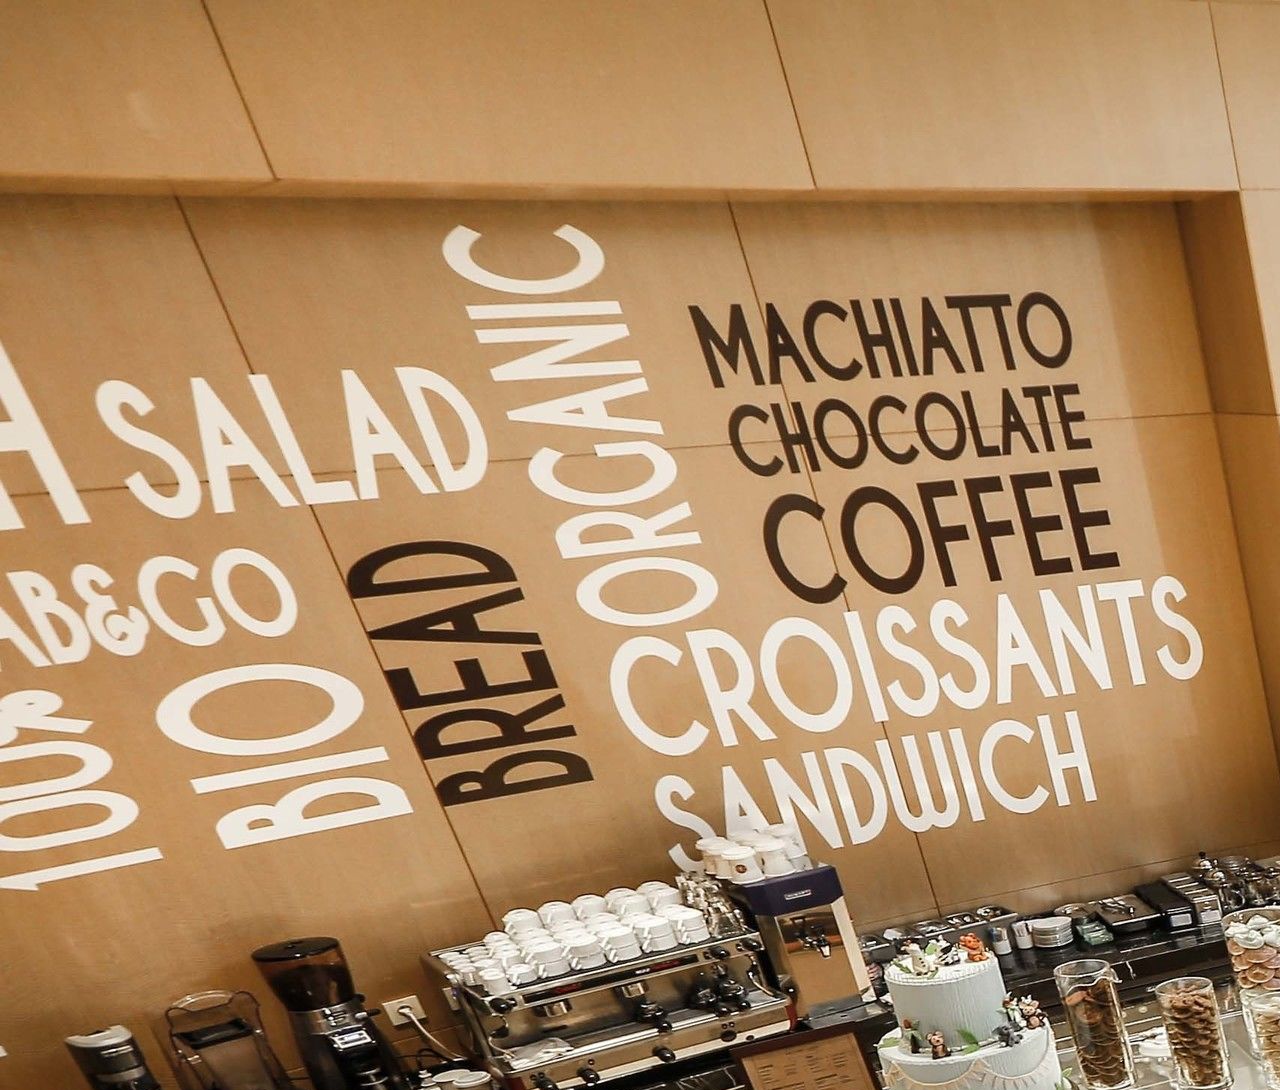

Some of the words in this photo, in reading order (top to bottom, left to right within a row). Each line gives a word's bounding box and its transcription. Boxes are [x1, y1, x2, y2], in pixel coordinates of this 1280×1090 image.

[688, 291, 1073, 389] MACHIATTO
[95, 366, 489, 519] SALAD
[442, 224, 718, 627] ORGANIC
[727, 383, 1093, 477] CHOCOLATE
[763, 467, 1121, 604] COFFEE
[346, 540, 595, 807] BREAD
[609, 575, 1204, 757] CROISSANTS
[155, 663, 414, 850] BIO
[654, 710, 1098, 873] SANDWICH
